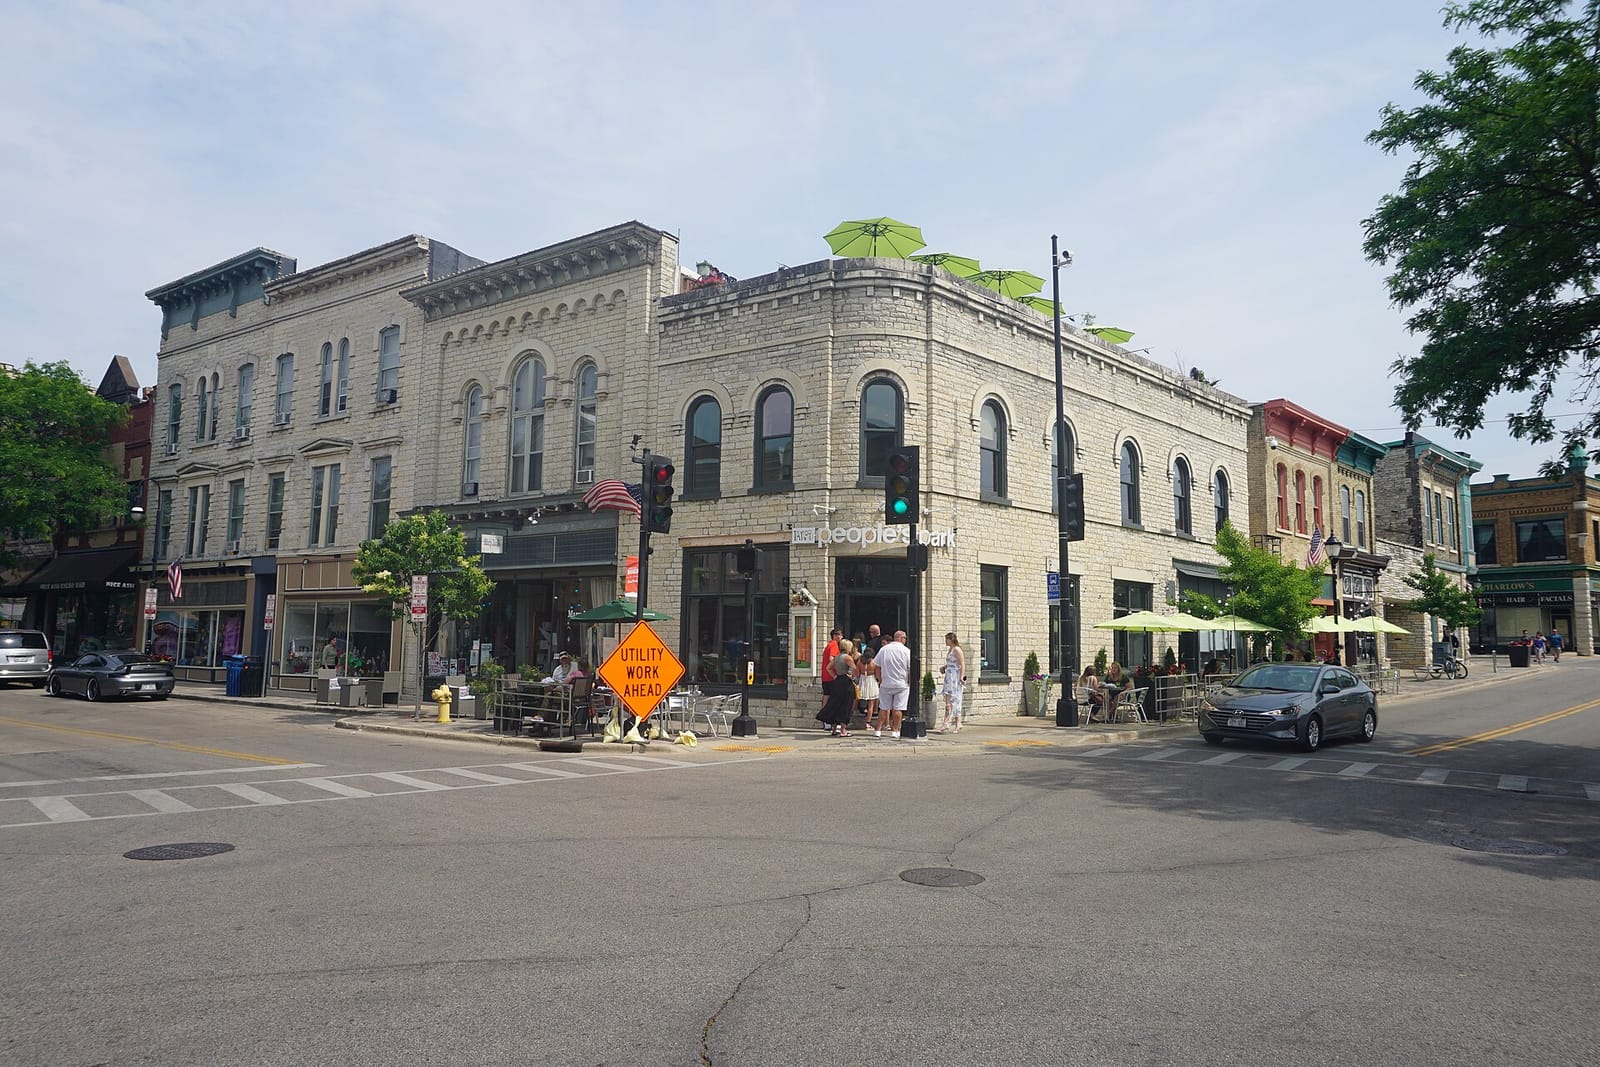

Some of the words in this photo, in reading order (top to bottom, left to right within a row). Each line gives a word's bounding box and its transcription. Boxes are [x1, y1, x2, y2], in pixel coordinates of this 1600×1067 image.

[817, 523, 910, 548] people's
[918, 527, 956, 548] park
[621, 648, 664, 661] UTILITY
[626, 666, 659, 679] WORK
[624, 683, 662, 697] AHEAD
